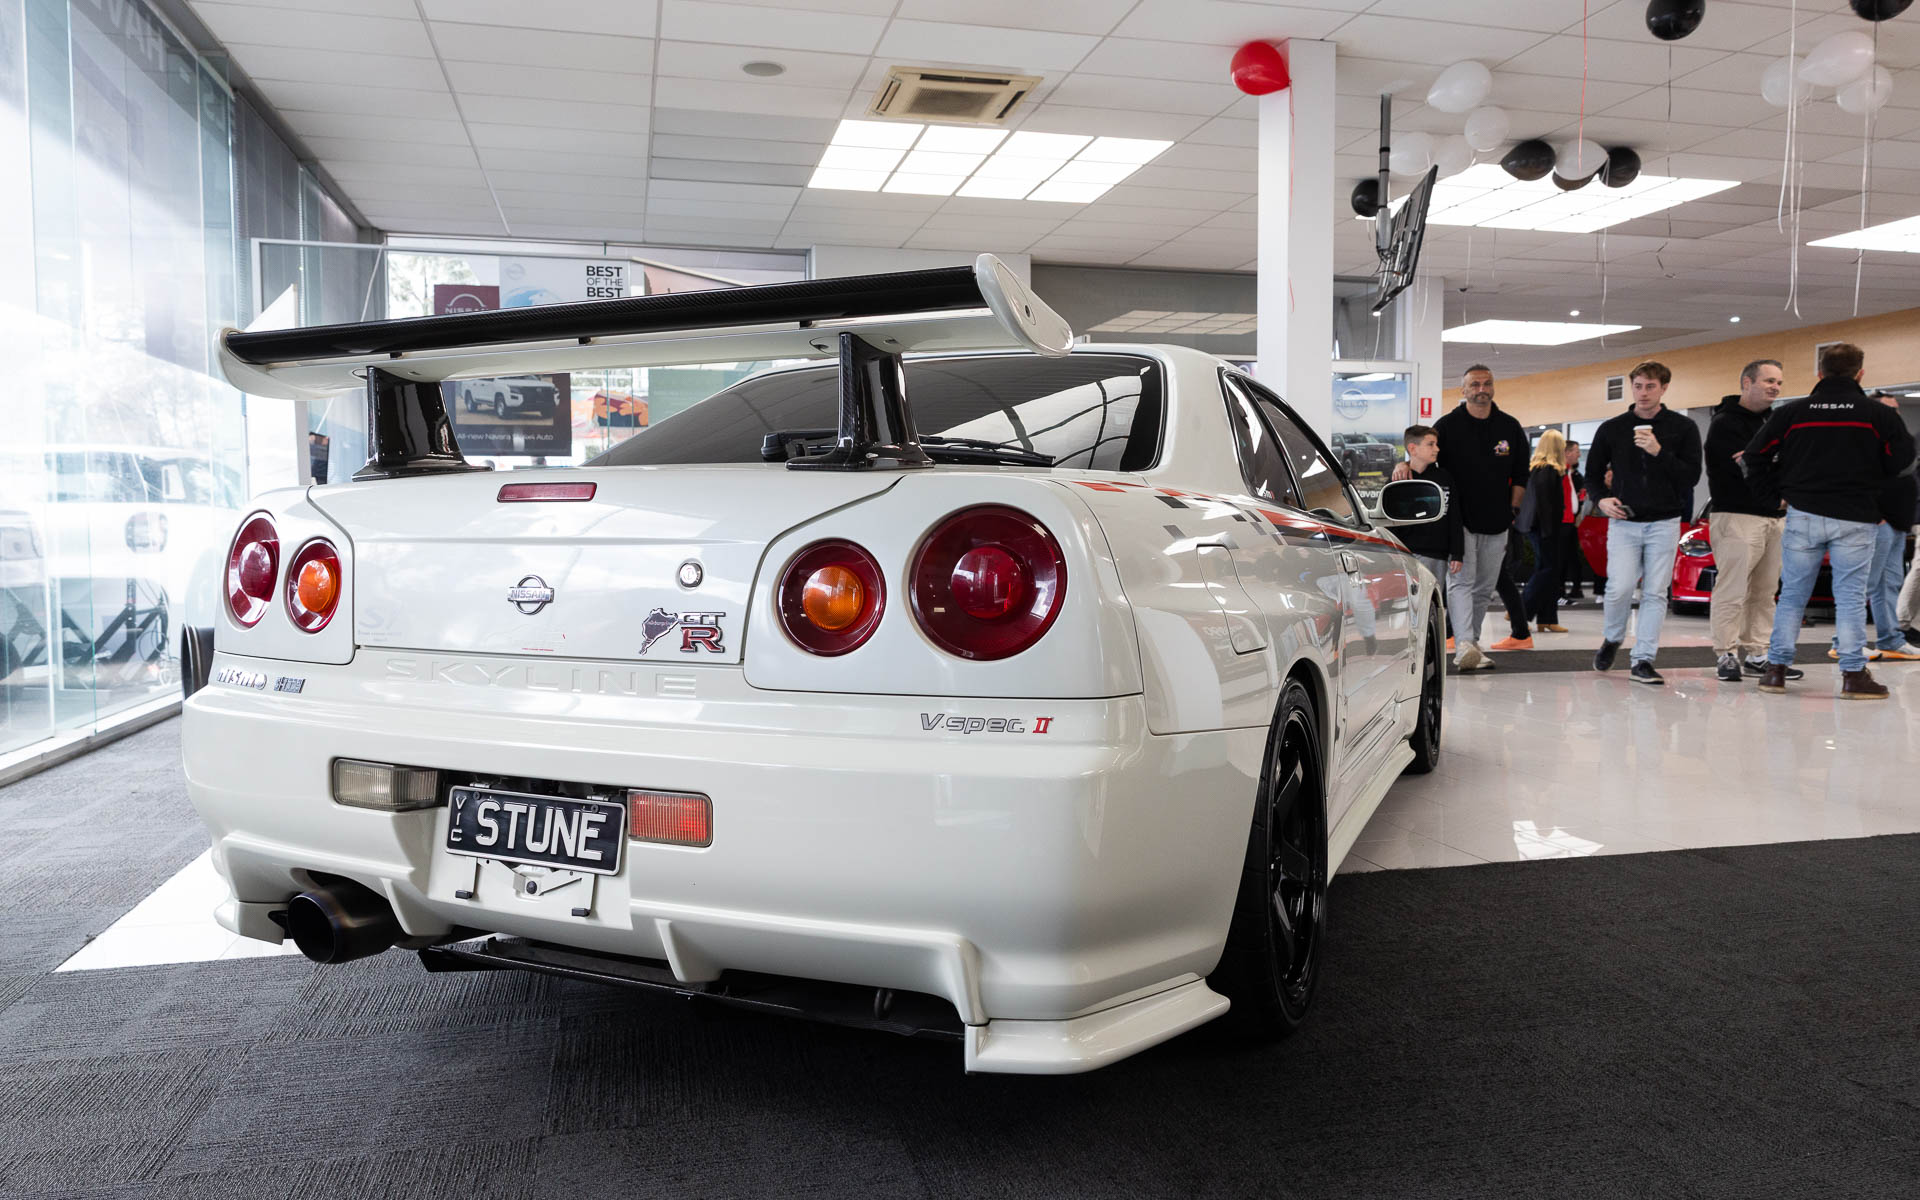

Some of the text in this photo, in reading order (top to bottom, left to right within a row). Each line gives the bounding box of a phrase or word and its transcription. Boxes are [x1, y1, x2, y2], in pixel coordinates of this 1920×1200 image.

[586, 266, 623, 277] BEST
[586, 277, 624, 287] OF THE
[586, 287, 624, 298] BEST
[445, 307, 489, 315] NISS
[536, 433, 554, 441] Auto
[1357, 489, 1381, 499] avar
[511, 589, 547, 599] NISSAN
[679, 611, 727, 625] GT
[679, 626, 726, 654] R
[385, 657, 698, 698] SKYLINE
[475, 798, 608, 861] STUNE
